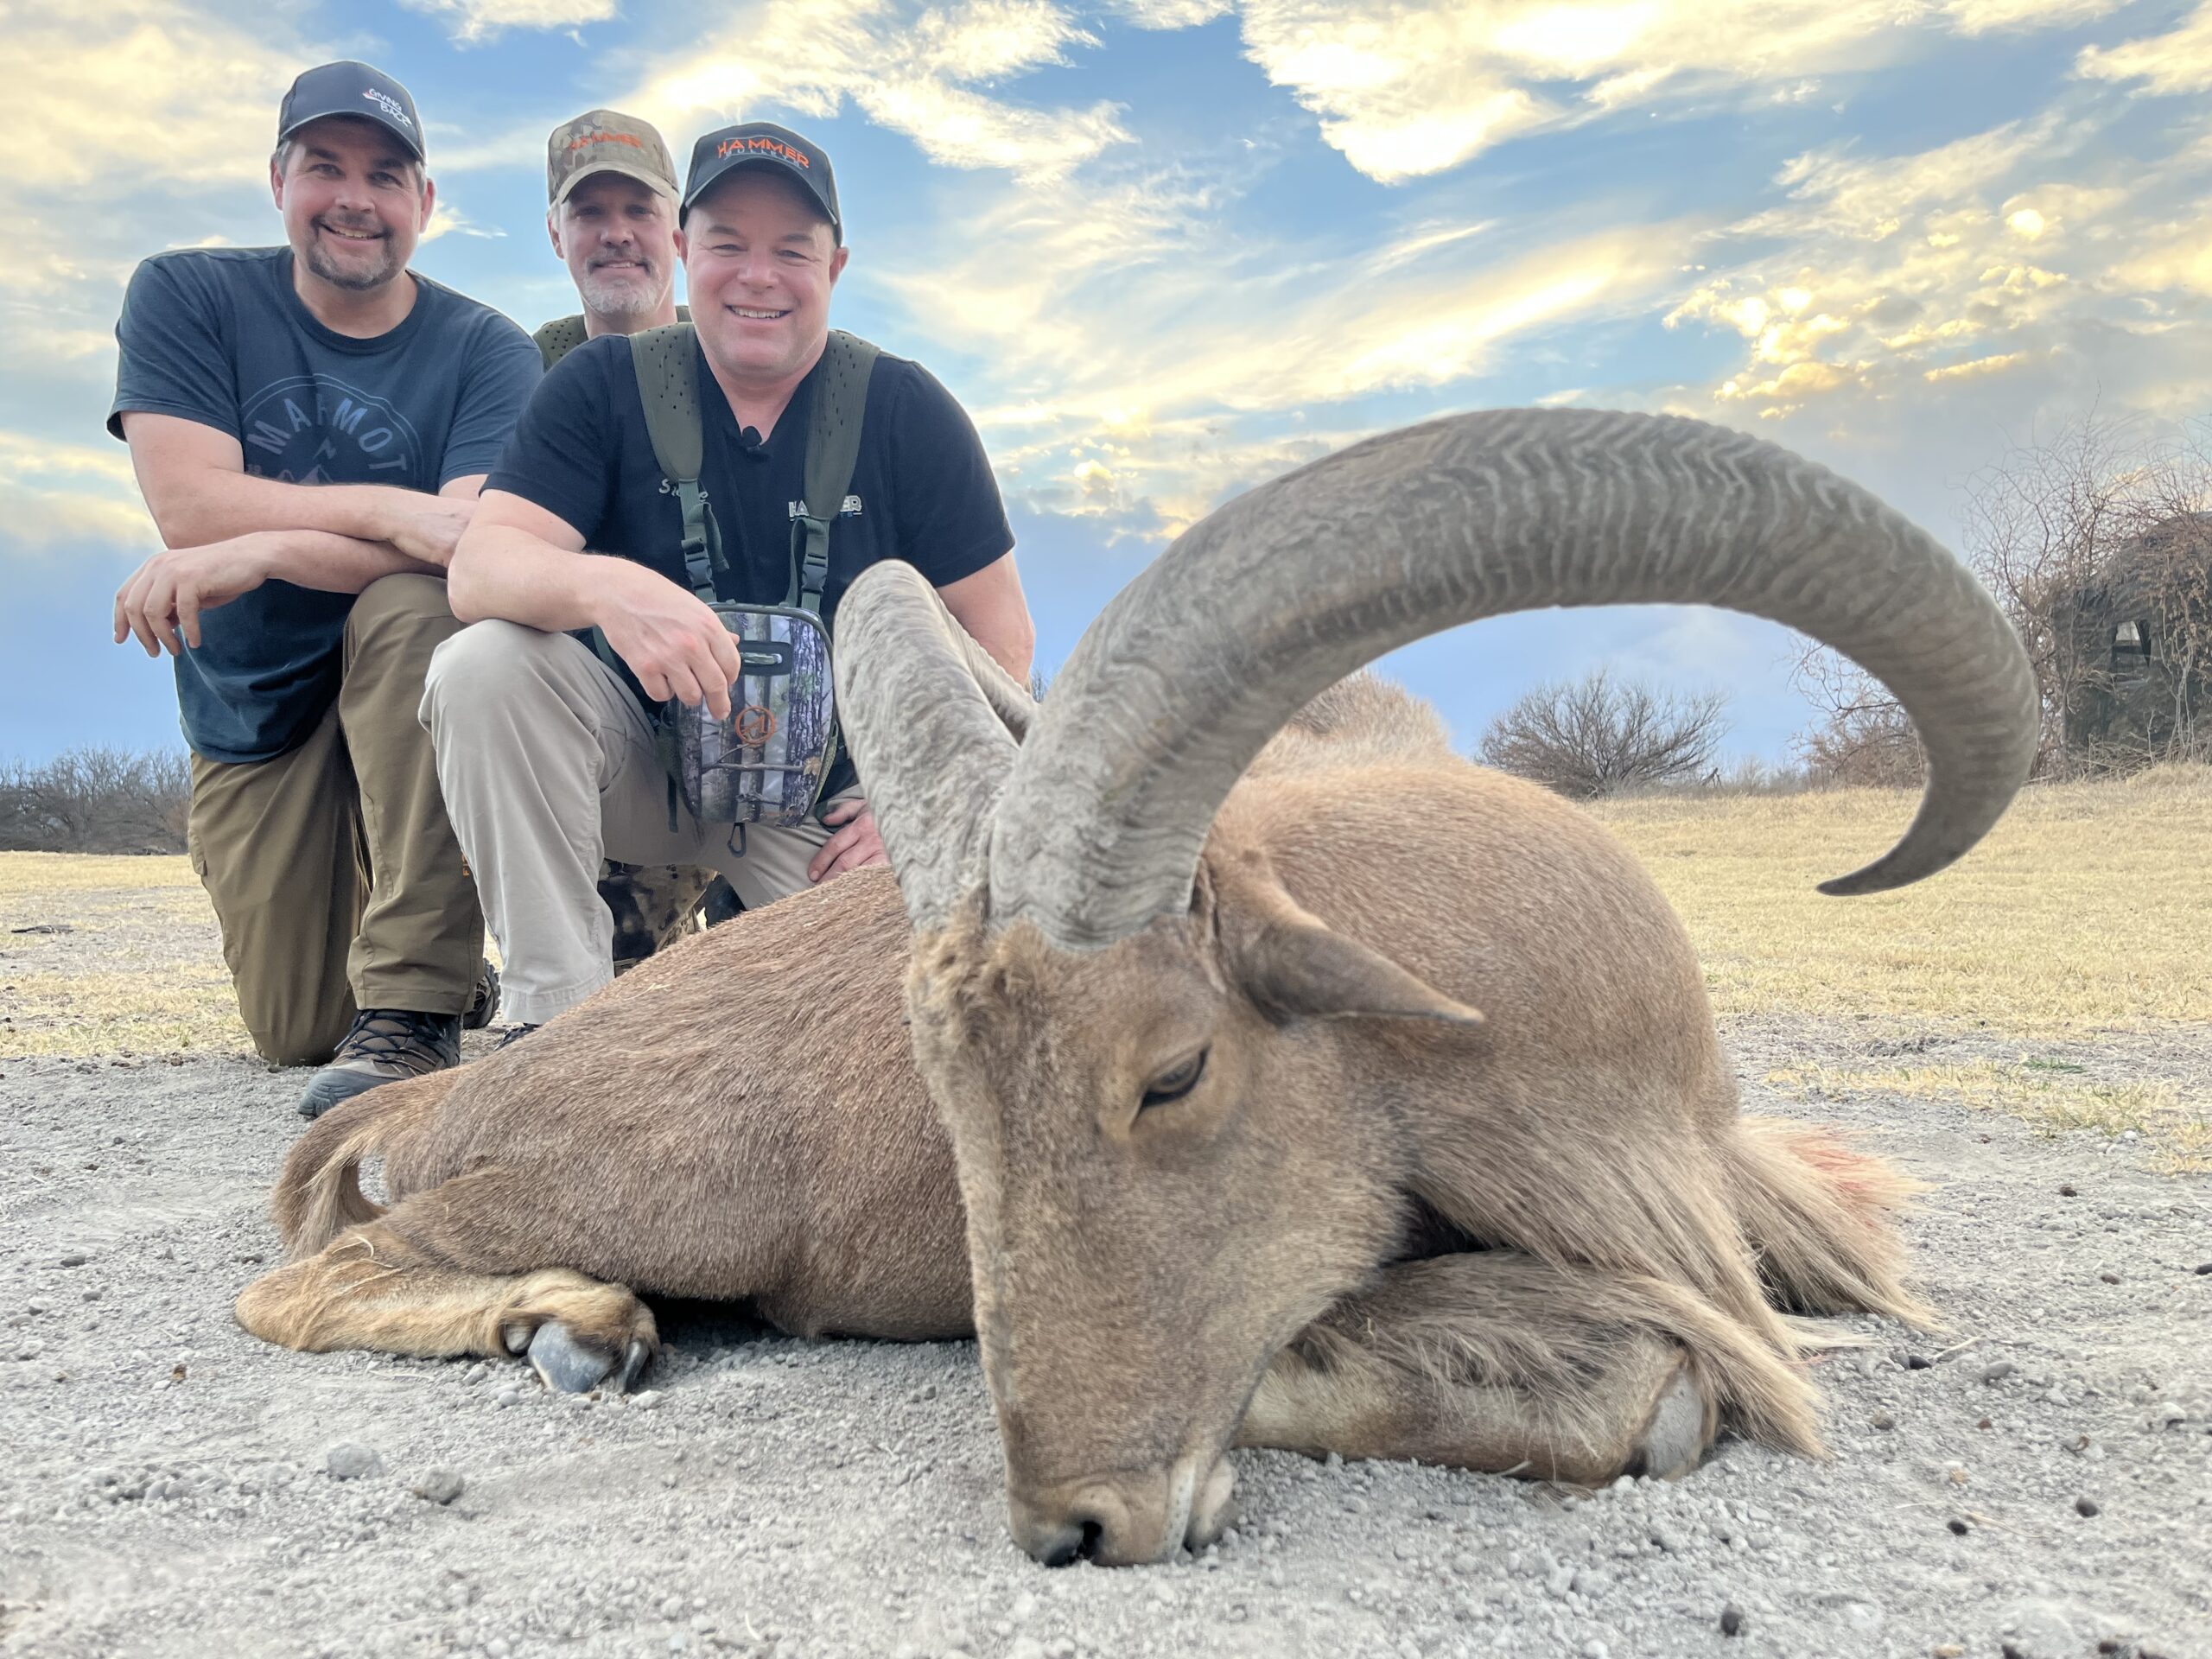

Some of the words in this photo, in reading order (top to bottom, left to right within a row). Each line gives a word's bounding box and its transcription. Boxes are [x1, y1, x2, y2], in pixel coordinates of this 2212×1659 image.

[369, 88, 403, 112] GIVING
[380, 101, 409, 128] BACK
[717, 138, 810, 169] HAMMER
[788, 494, 862, 518] HAER
